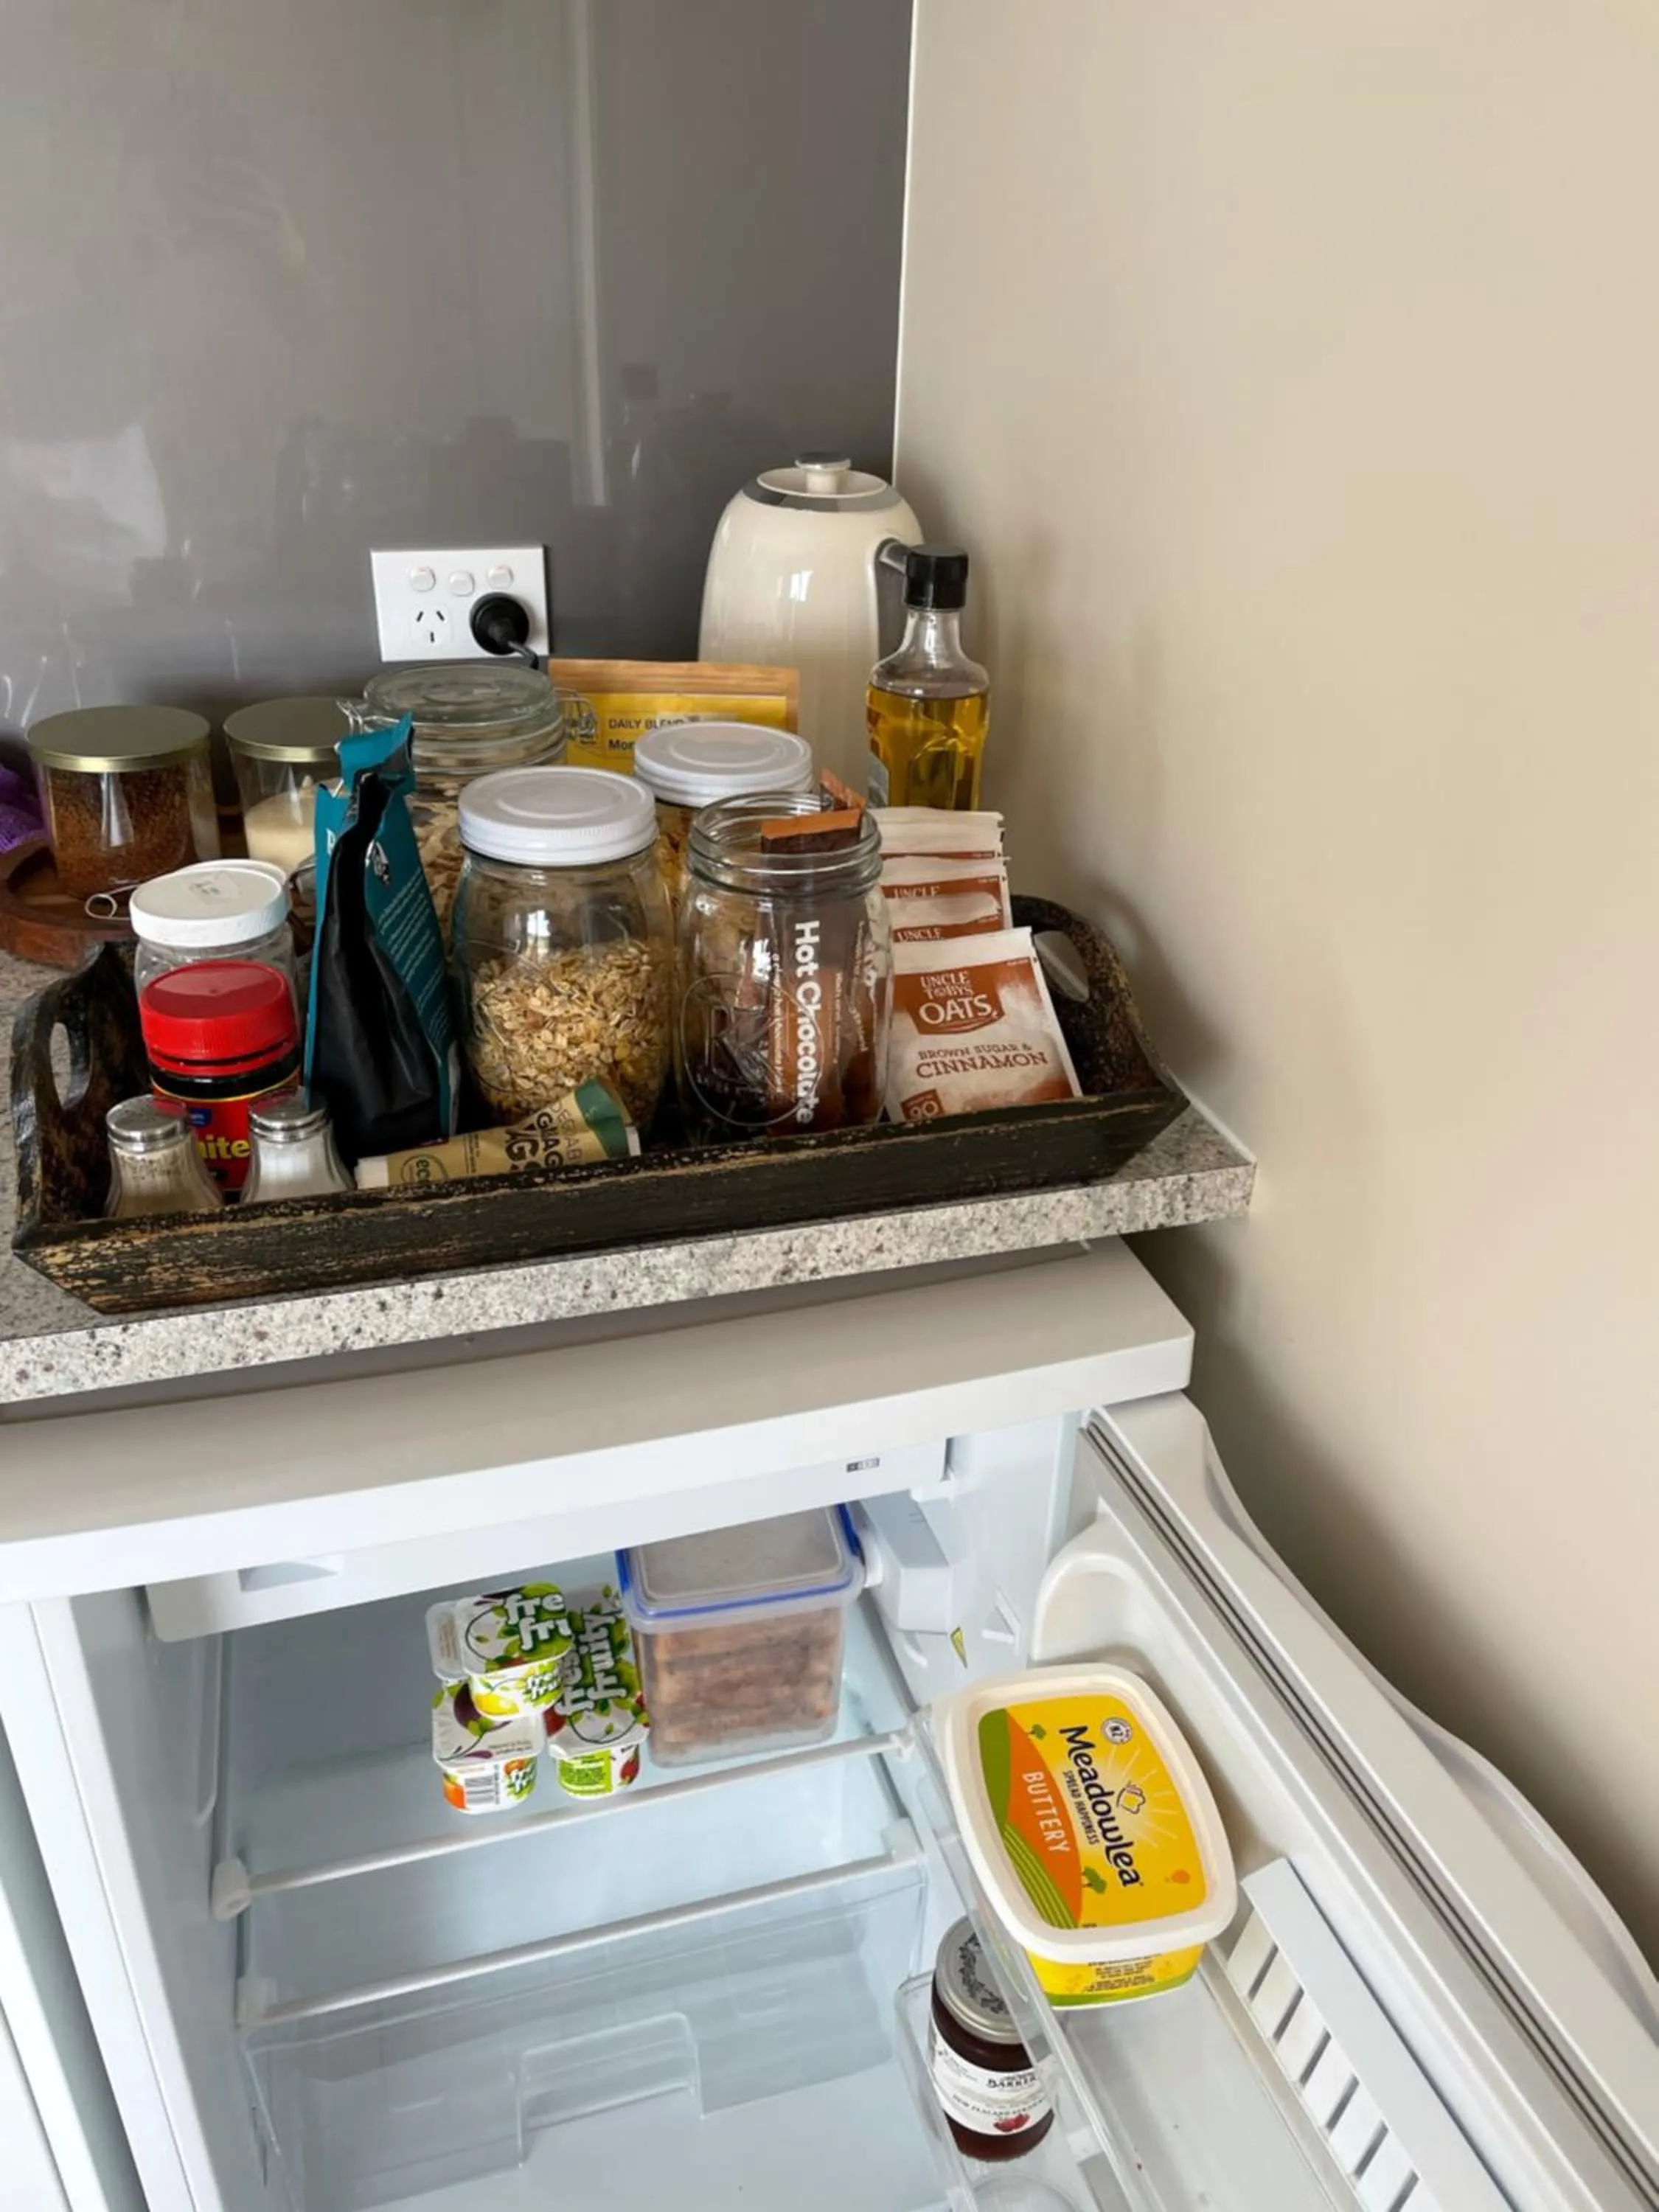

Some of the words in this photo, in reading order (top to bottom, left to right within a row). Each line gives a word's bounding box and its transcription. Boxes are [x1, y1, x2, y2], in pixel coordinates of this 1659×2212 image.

[608, 718, 641, 729] DAILY
[796, 920, 820, 978] Hot
[920, 971, 971, 989] UNCLE
[919, 994, 992, 1024] OATS
[796, 981, 821, 1123] Chocolate
[916, 1051, 1048, 1079] CINNAMON
[919, 1047, 970, 1060] BROWN
[974, 1043, 1018, 1054] SUGAR
[1023, 1771, 1071, 1853] BUTTERY
[1062, 1769, 1082, 1804] SPREAD
[1074, 1797, 1100, 1846] HAPPINESS
